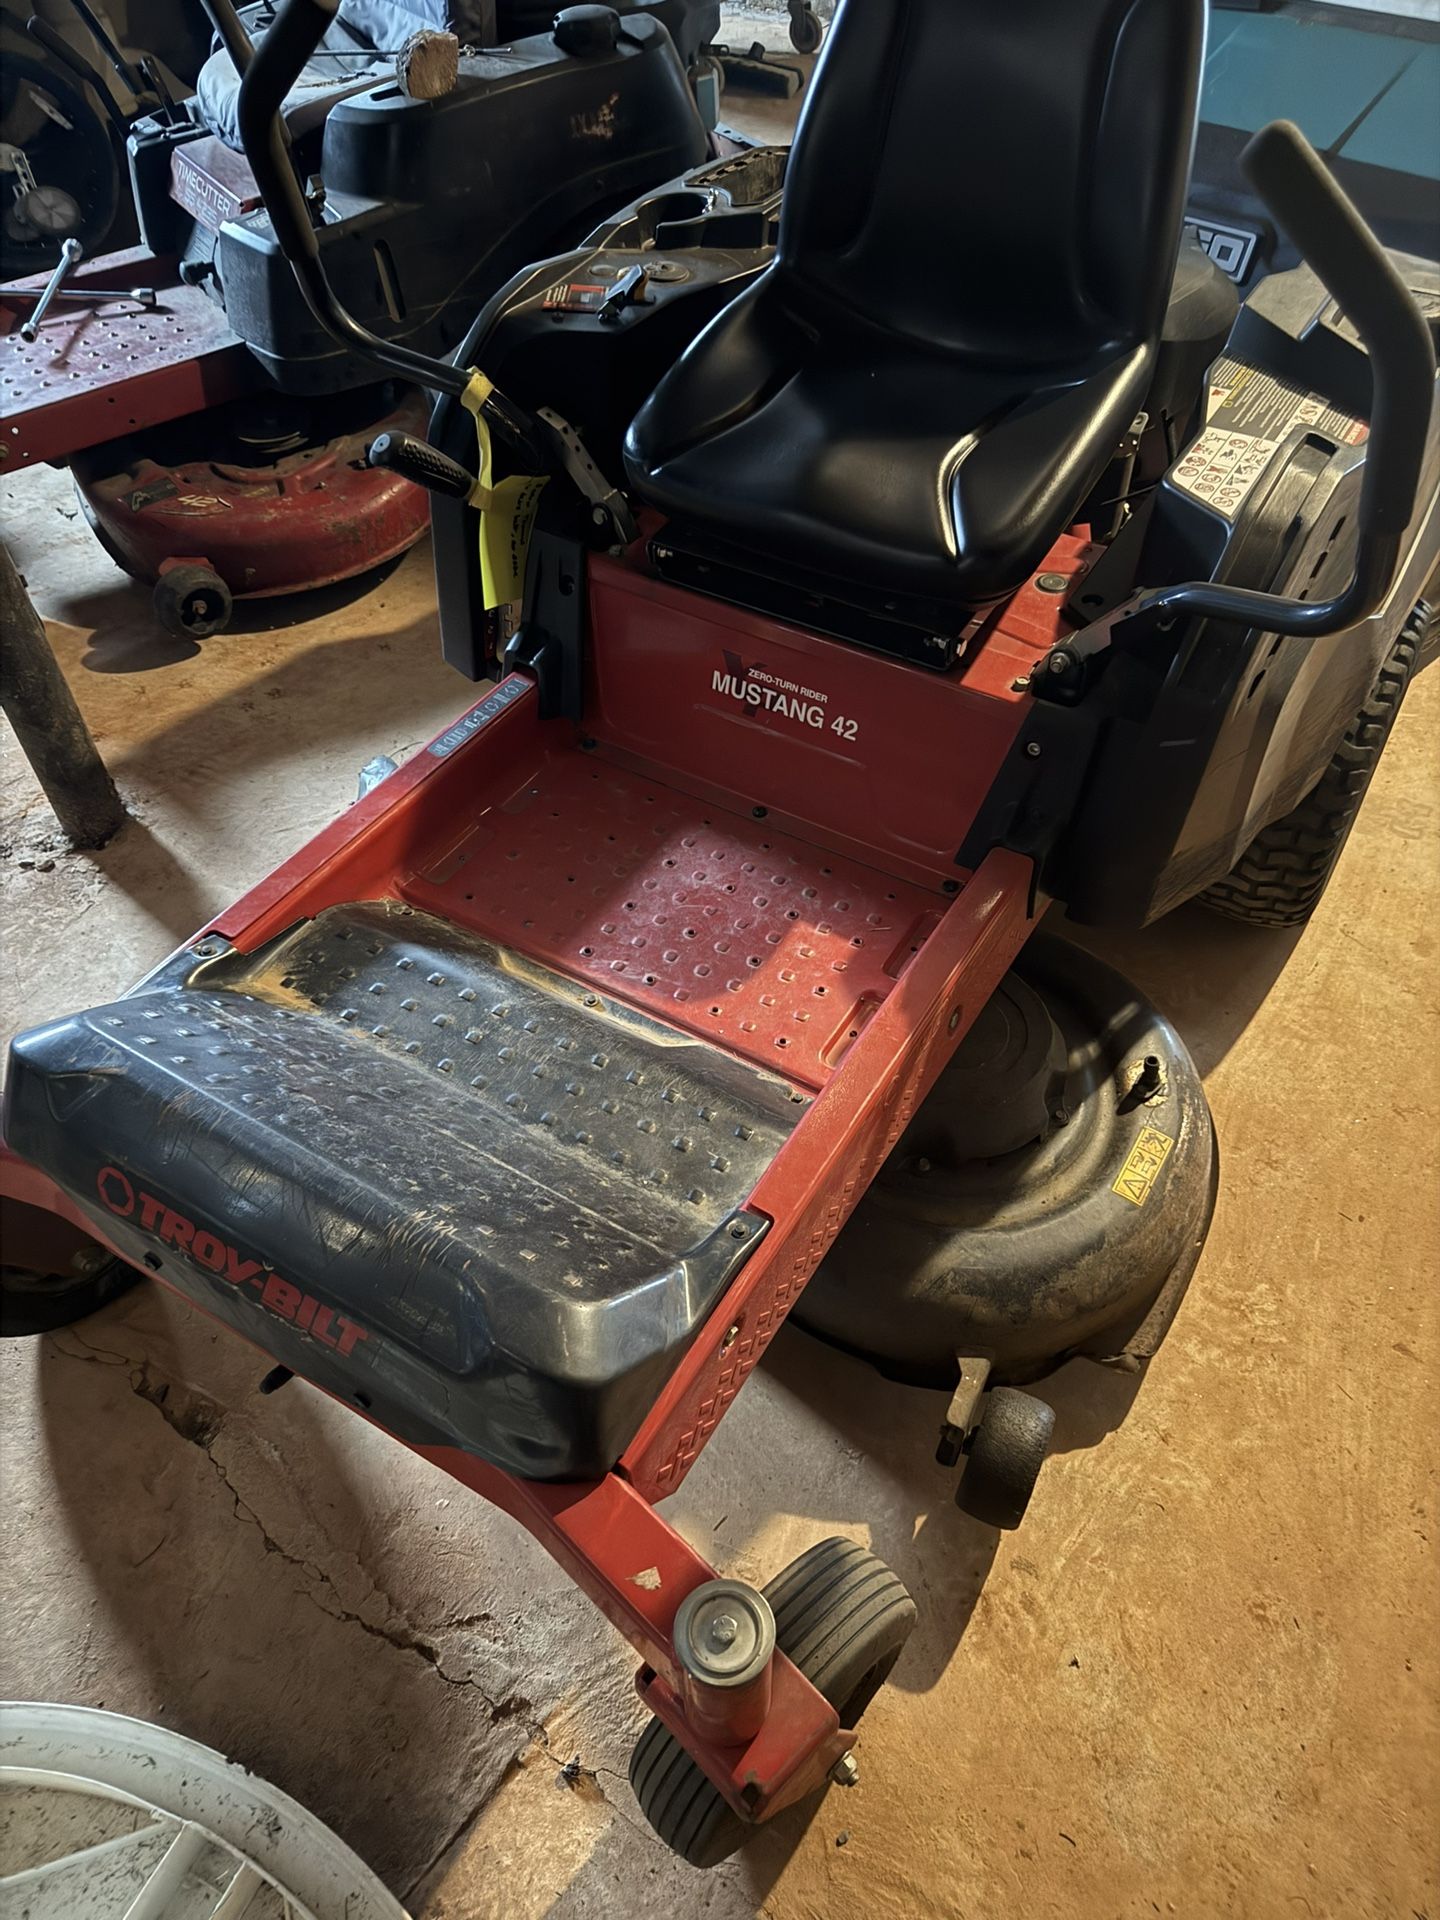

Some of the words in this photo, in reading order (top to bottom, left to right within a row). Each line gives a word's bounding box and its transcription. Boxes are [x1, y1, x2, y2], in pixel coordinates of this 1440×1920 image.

[178, 160, 231, 217] TIMECUTTER
[712, 670, 825, 729] MUSTANG
[831, 716, 859, 741] 42
[748, 668, 799, 693] ZERO-TURN
[800, 687, 828, 703] RIDER
[139, 1192, 369, 1358] TROY-BILT
